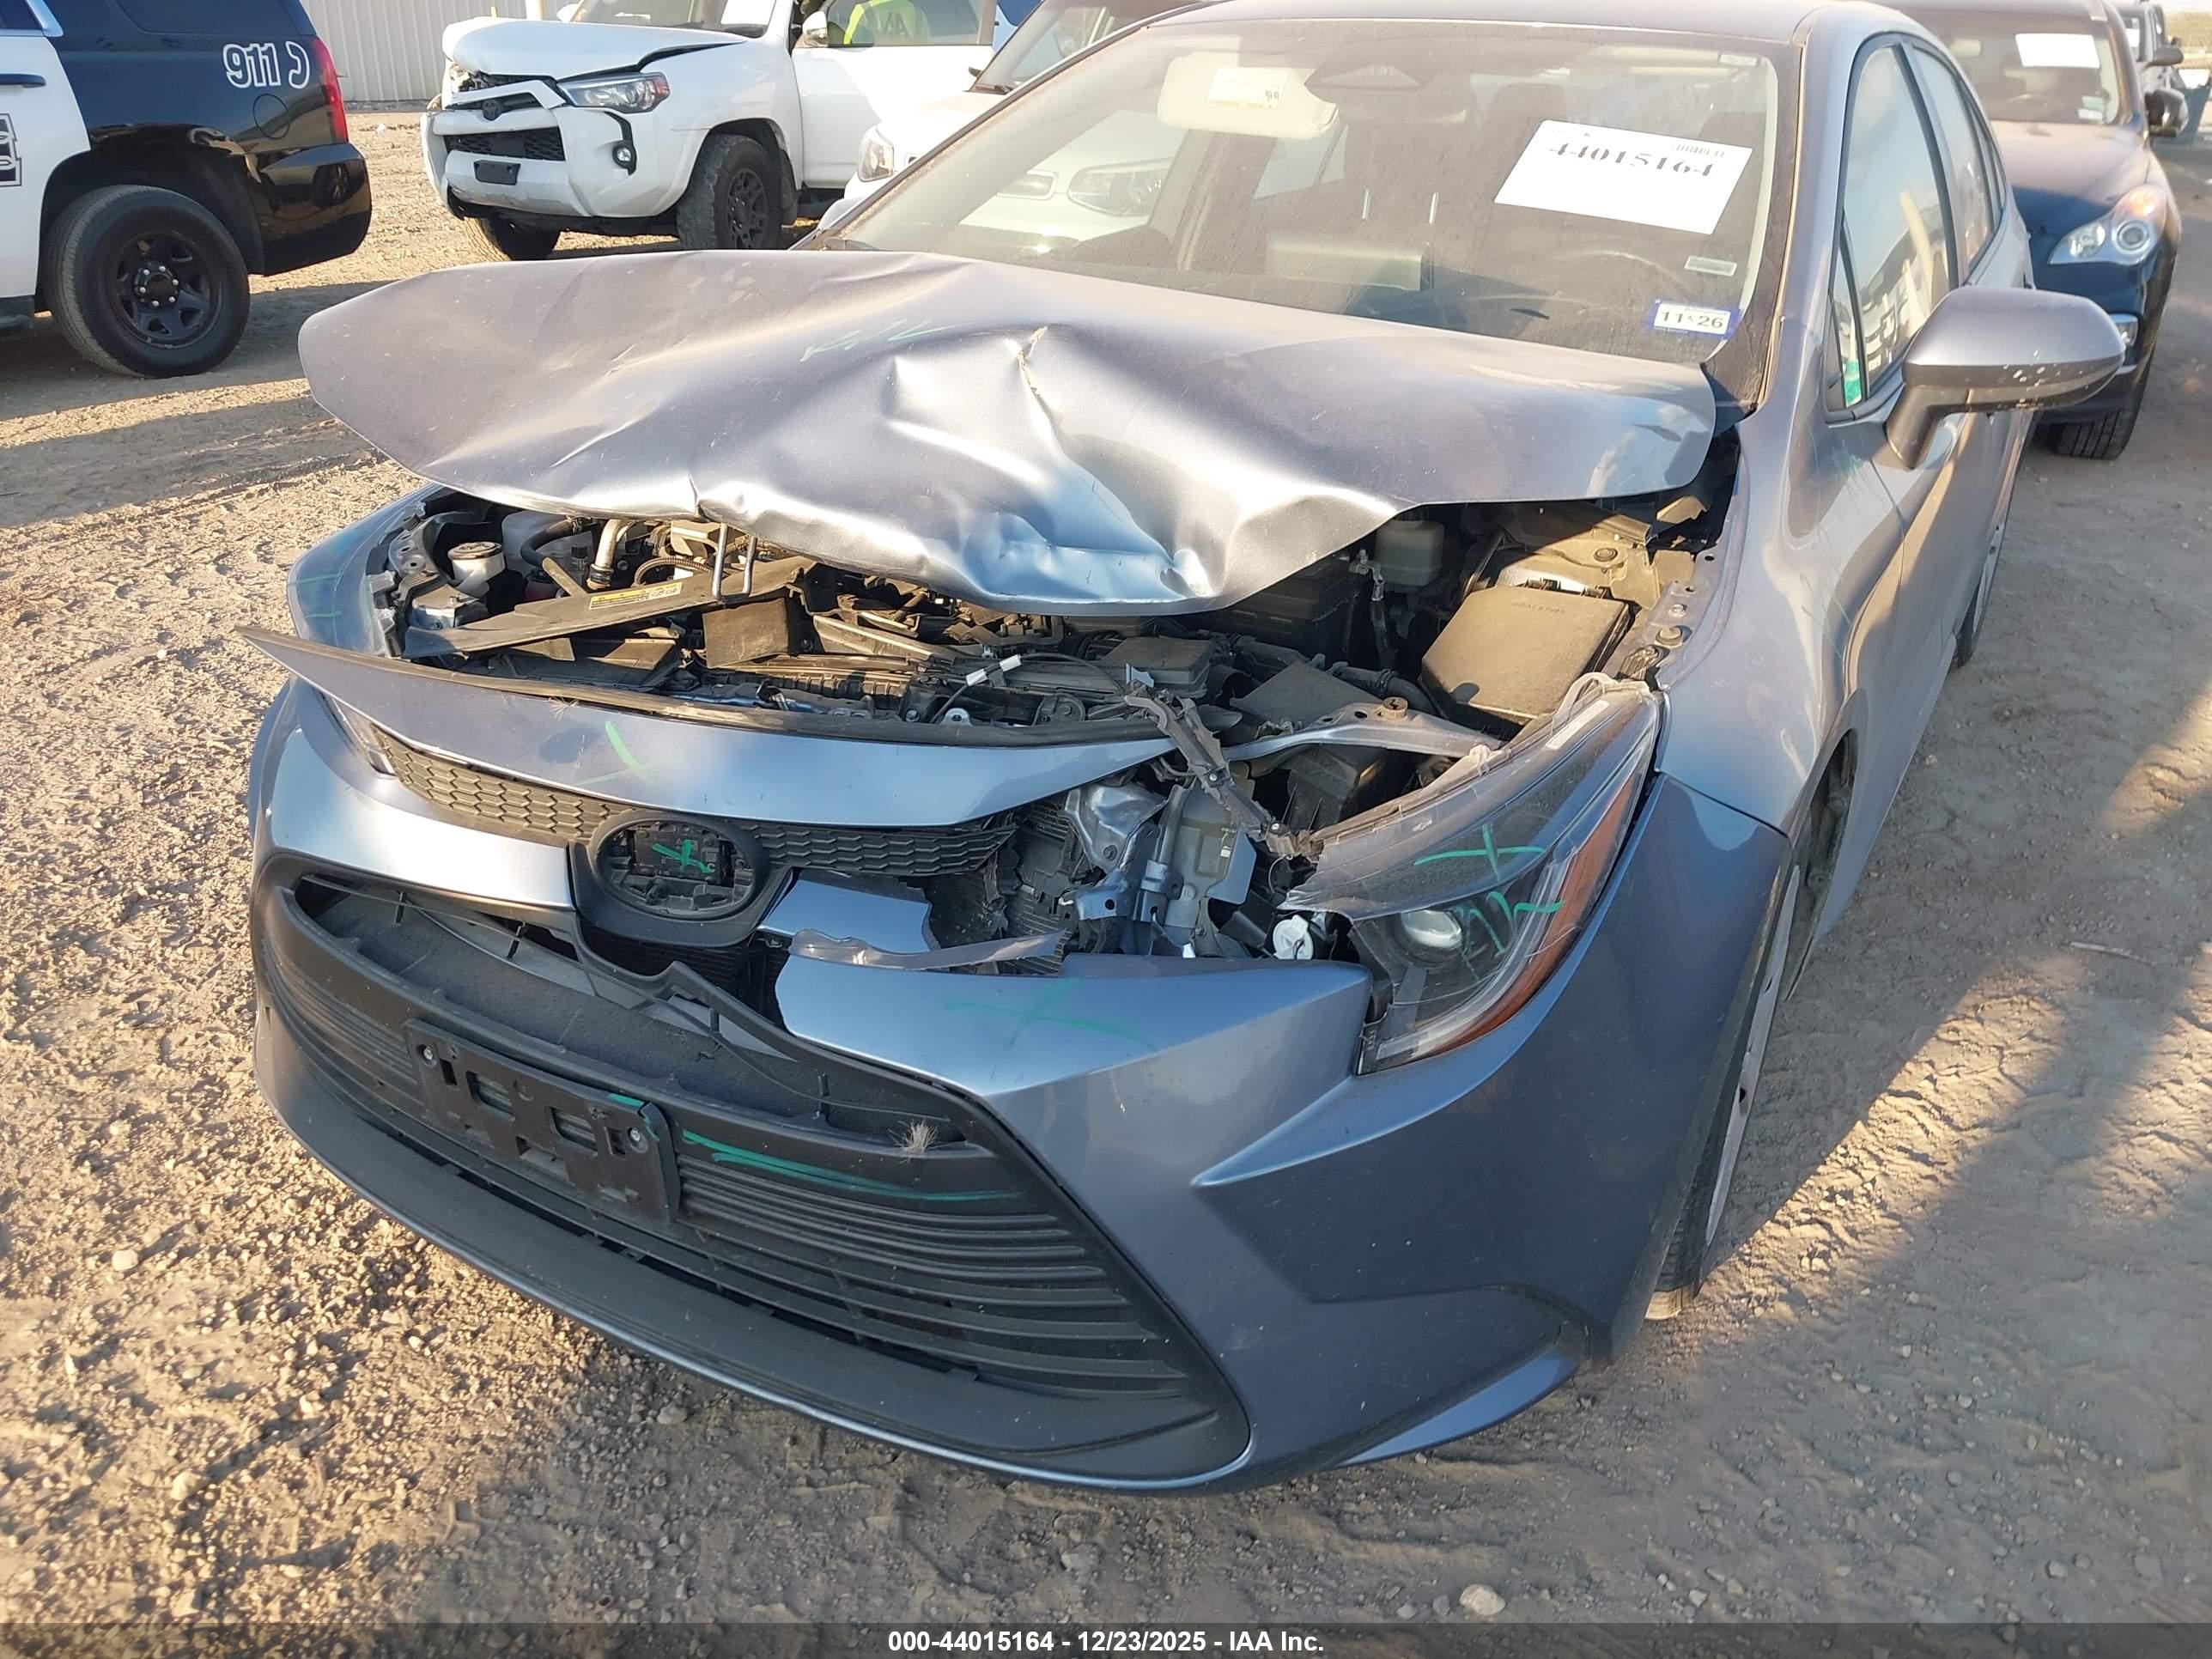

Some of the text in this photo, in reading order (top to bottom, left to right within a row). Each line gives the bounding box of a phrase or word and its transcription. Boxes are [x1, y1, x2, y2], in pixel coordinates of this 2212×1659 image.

[222, 42, 282, 88] 911
[1549, 143, 1714, 177] 44015164
[1661, 311, 1724, 329] 11 26
